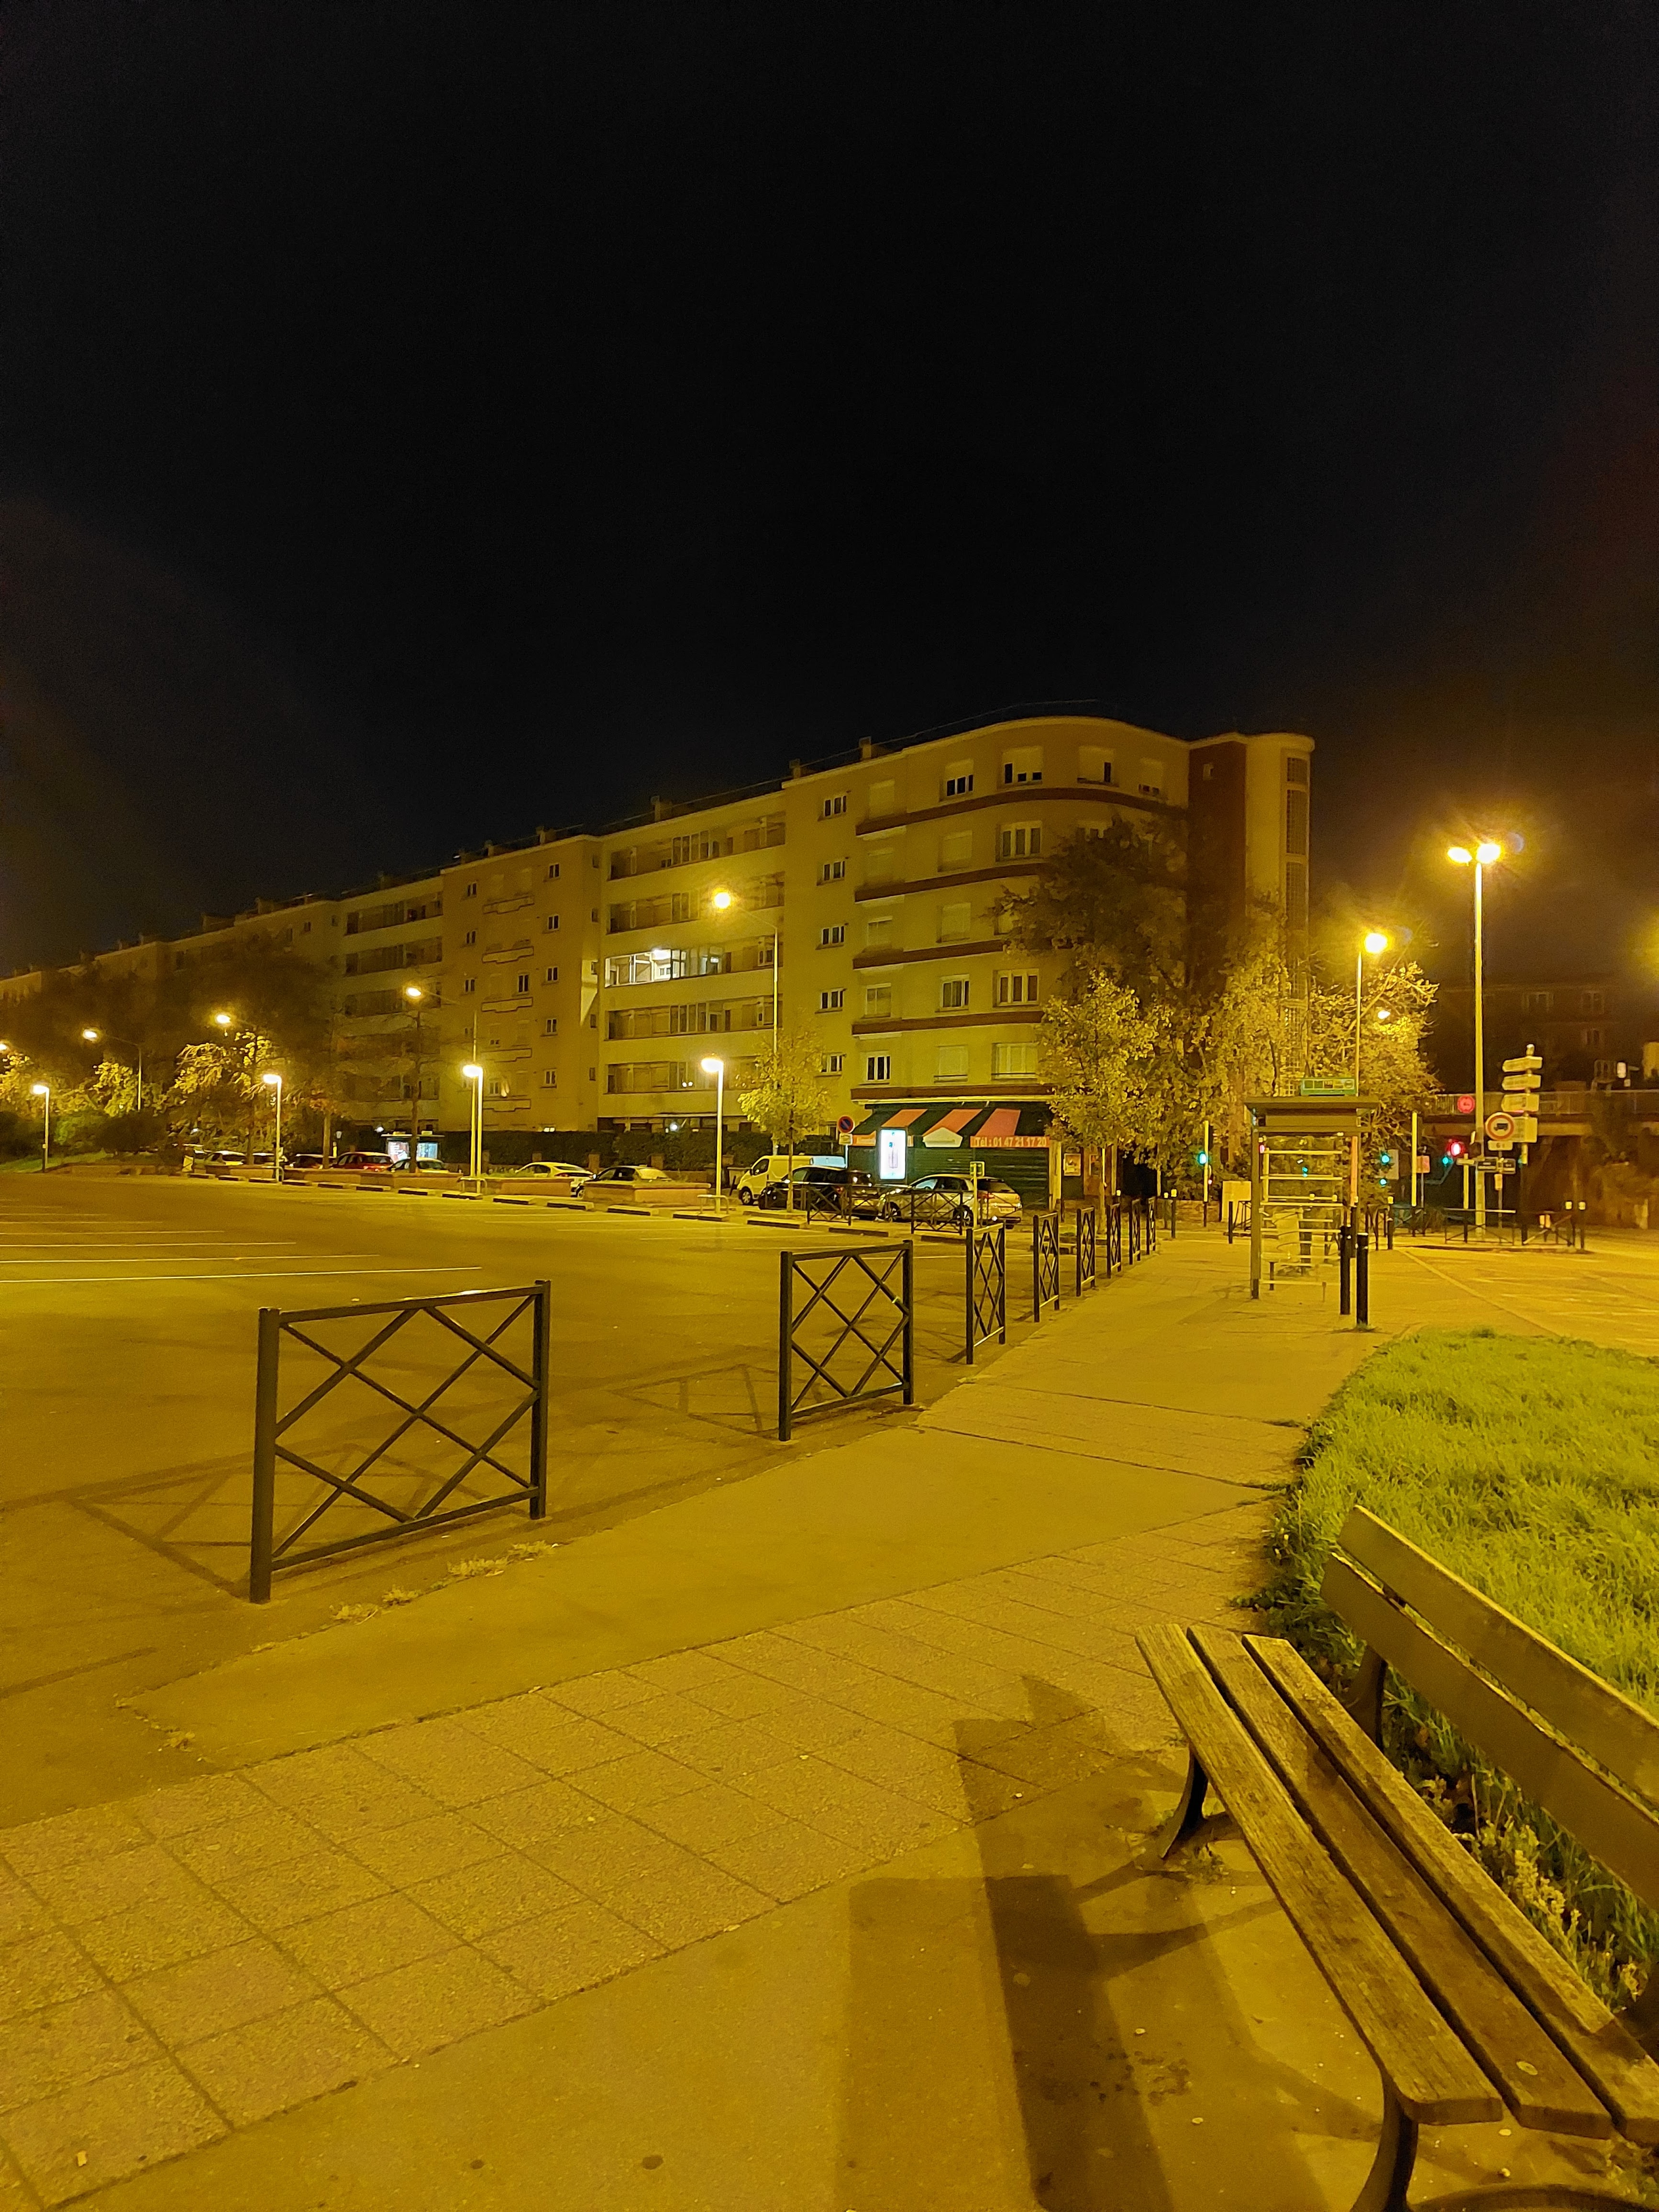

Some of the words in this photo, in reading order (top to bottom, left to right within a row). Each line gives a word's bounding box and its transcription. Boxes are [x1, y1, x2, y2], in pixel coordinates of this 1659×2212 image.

[993, 1137, 1002, 1147] 01
[1004, 1137, 1014, 1147] 47
[1015, 1137, 1024, 1147] 21
[1026, 1137, 1036, 1147] 17
[1037, 1137, 1047, 1147] 20
